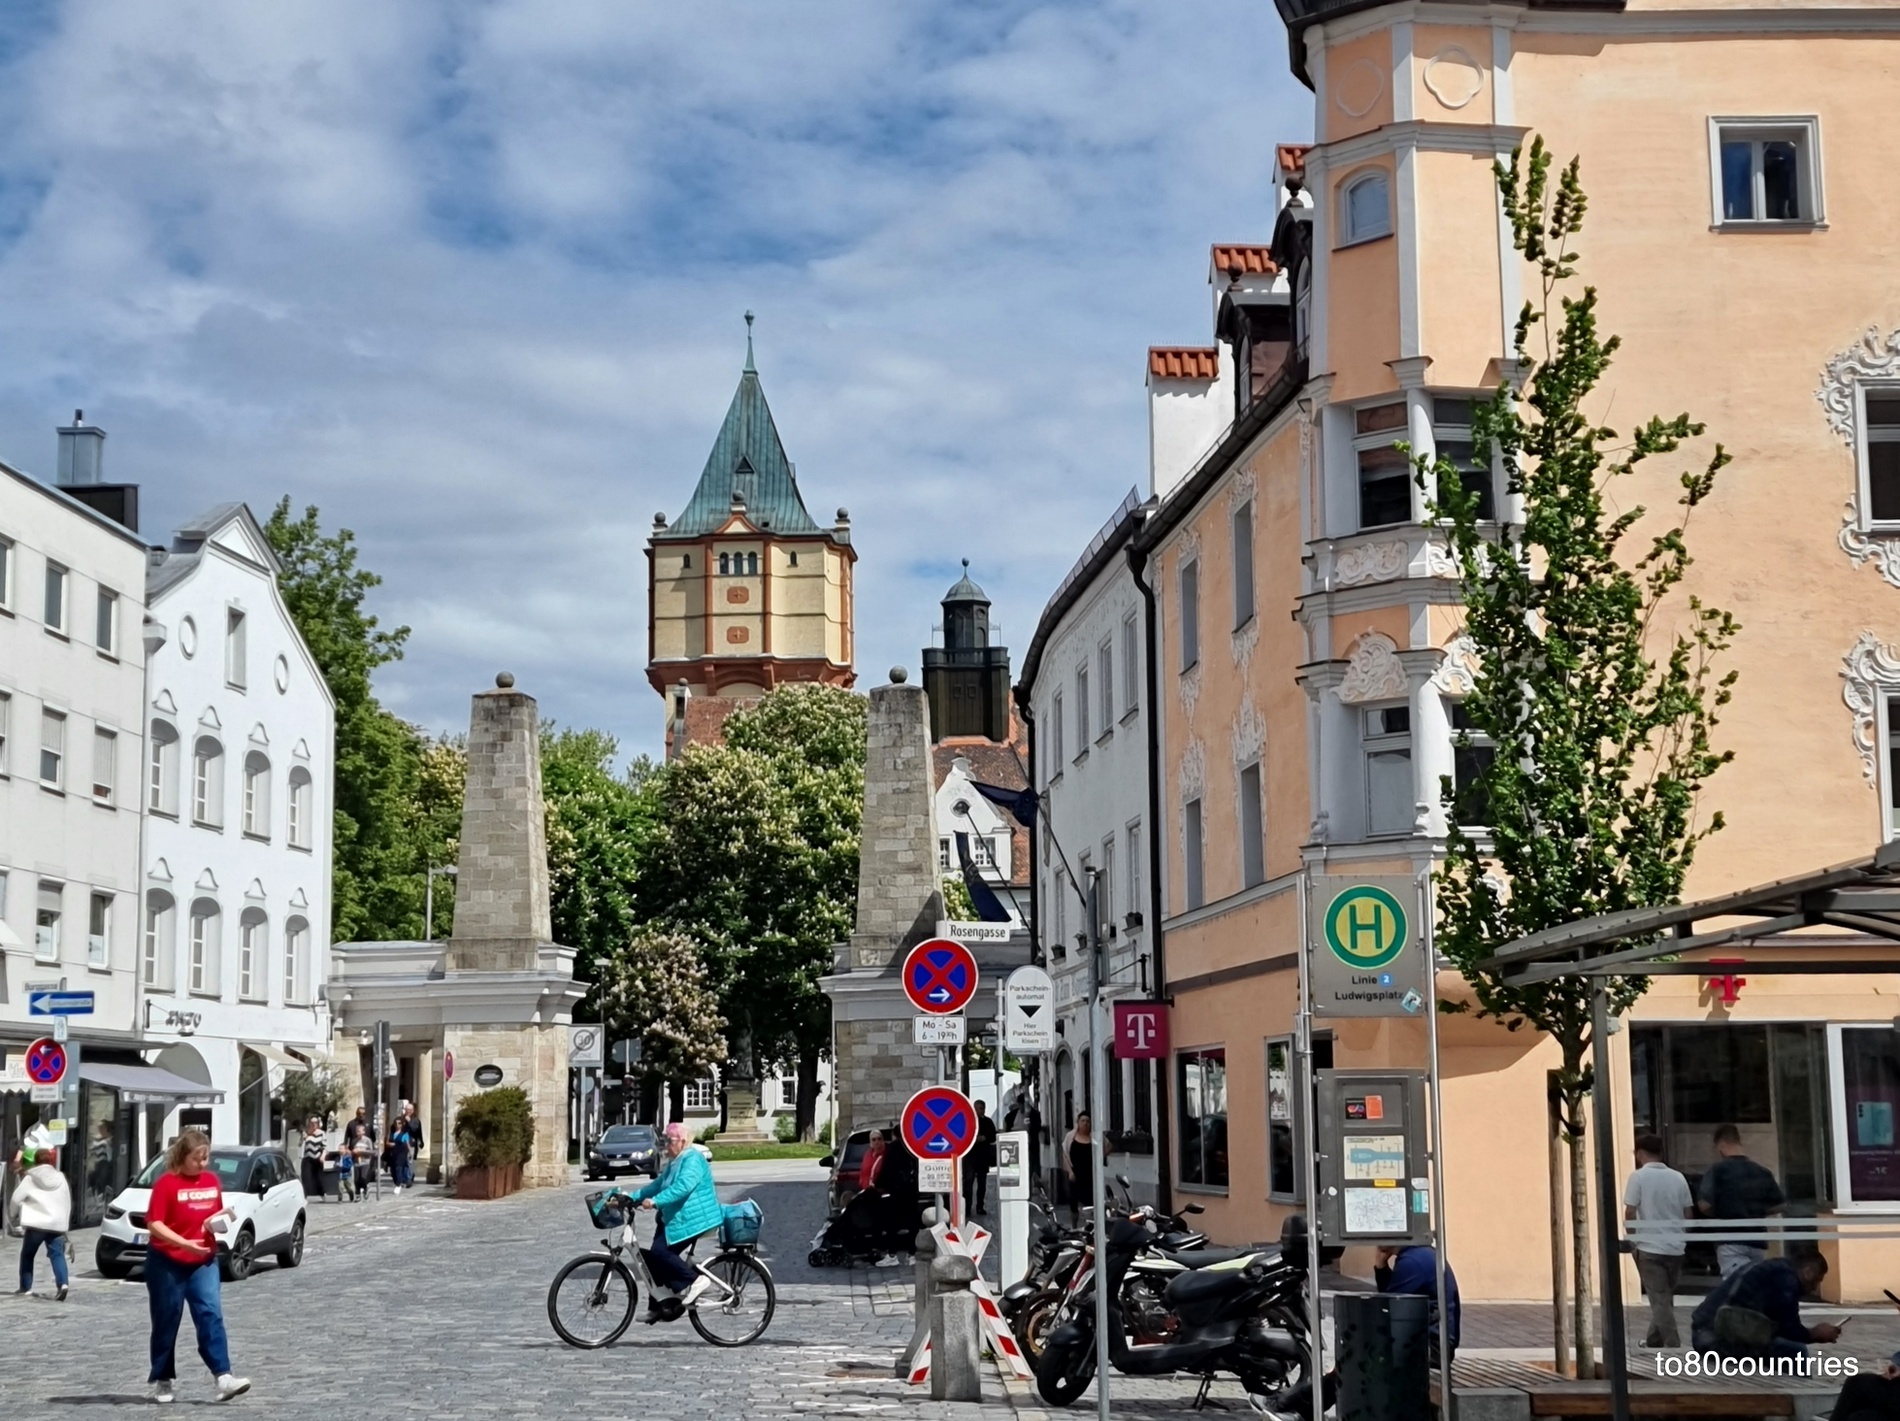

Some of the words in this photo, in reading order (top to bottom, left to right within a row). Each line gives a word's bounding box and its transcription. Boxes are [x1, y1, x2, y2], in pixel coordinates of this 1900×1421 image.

[950, 924, 1006, 940] Rosengasse
[1349, 904, 1382, 949] H
[1351, 976, 1378, 985] Linie
[1335, 991, 1405, 1002] Ludwigsplatz
[922, 1020, 936, 1029] Mo
[945, 1020, 957, 1029] Sa
[922, 1031, 928, 1040] 6
[1127, 1013, 1156, 1049] T
[577, 1035, 591, 1046] 30
